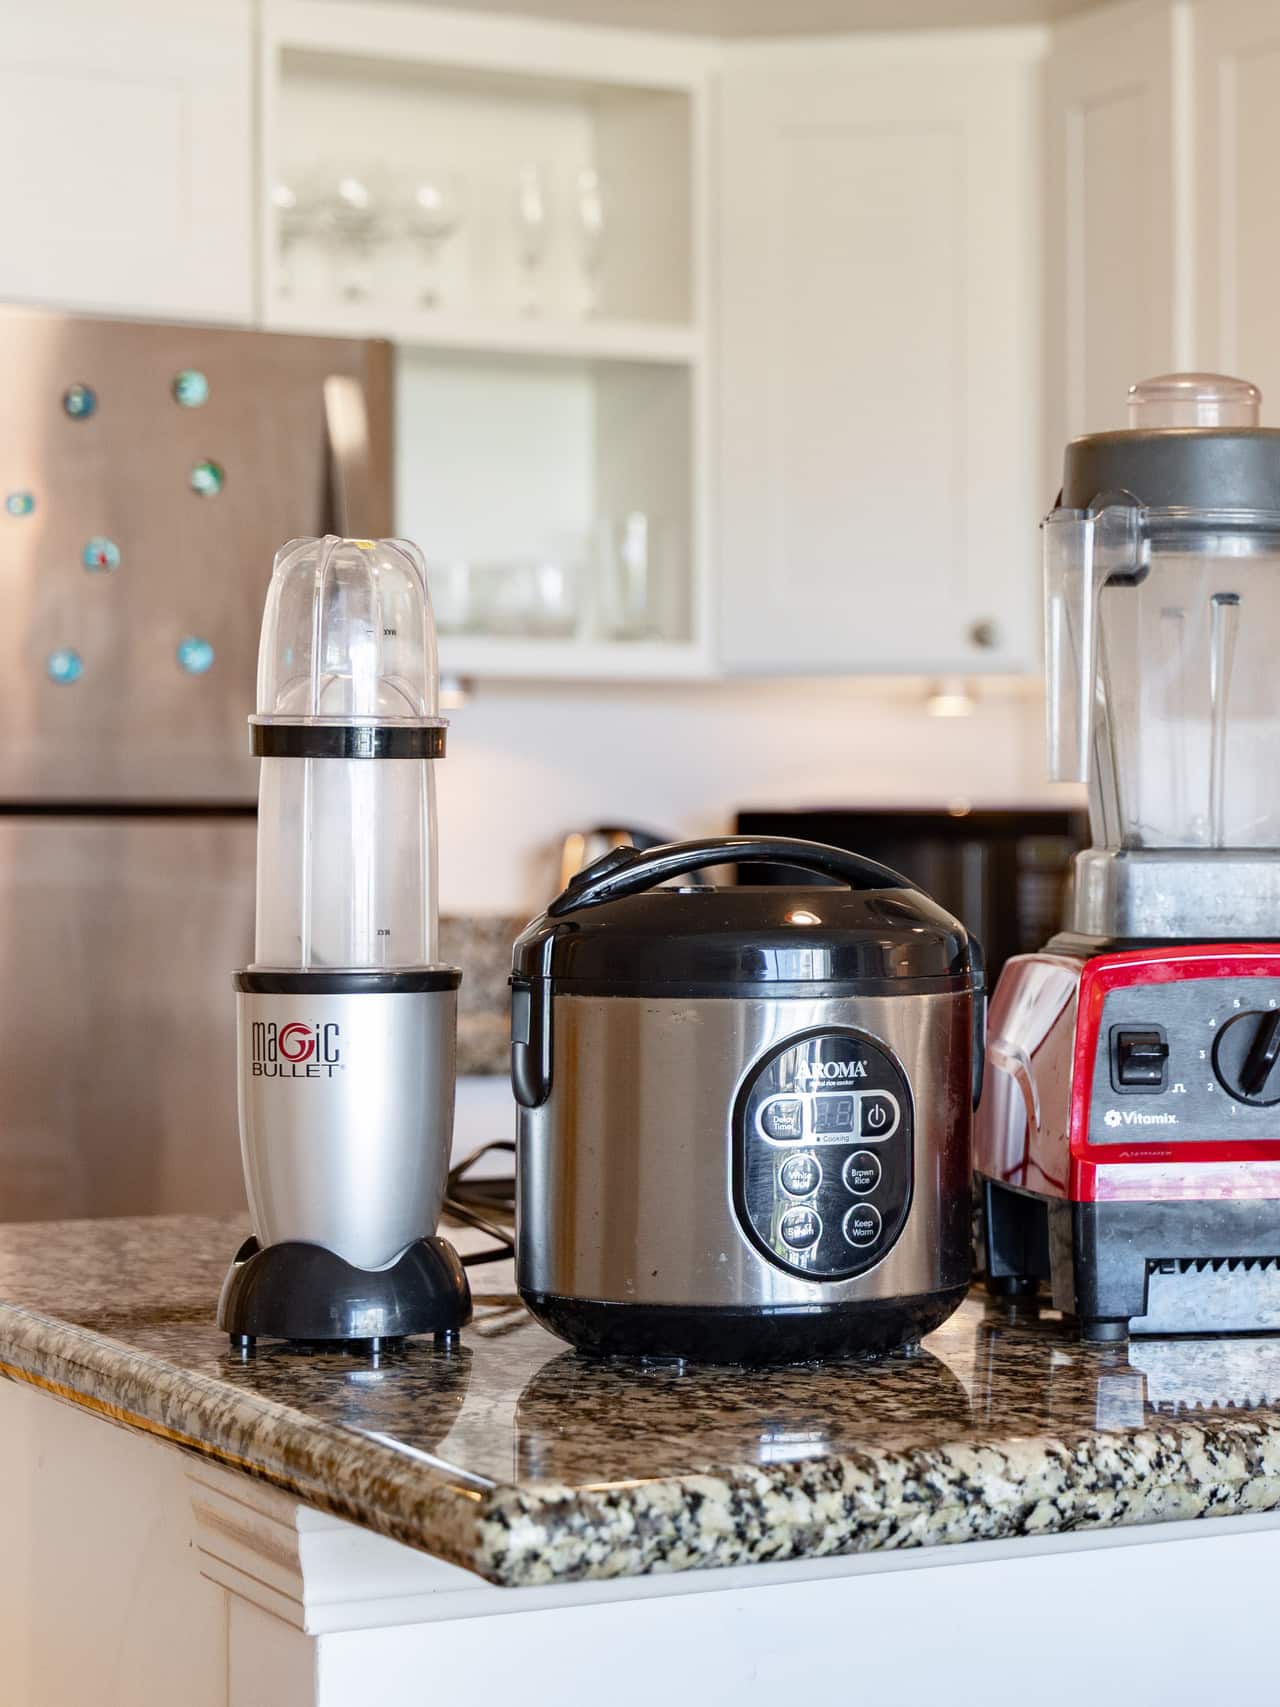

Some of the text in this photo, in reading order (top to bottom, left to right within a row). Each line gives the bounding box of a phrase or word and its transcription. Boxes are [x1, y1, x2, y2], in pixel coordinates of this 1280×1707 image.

[1233, 1000, 1240, 1008] 5
[1269, 1000, 1276, 1008] 6
[1208, 1019, 1216, 1027] 4
[1200, 1050, 1206, 1059] 3
[252, 1063, 340, 1078] BULLET
[794, 1060, 868, 1080] AROMA
[1207, 1083, 1214, 1091] 2
[1122, 1111, 1177, 1124] Vitamix
[823, 1135, 849, 1143] Cooking
[851, 1168, 874, 1177] Brown
[854, 1220, 874, 1228] Keep
[852, 1228, 874, 1236] Warm
